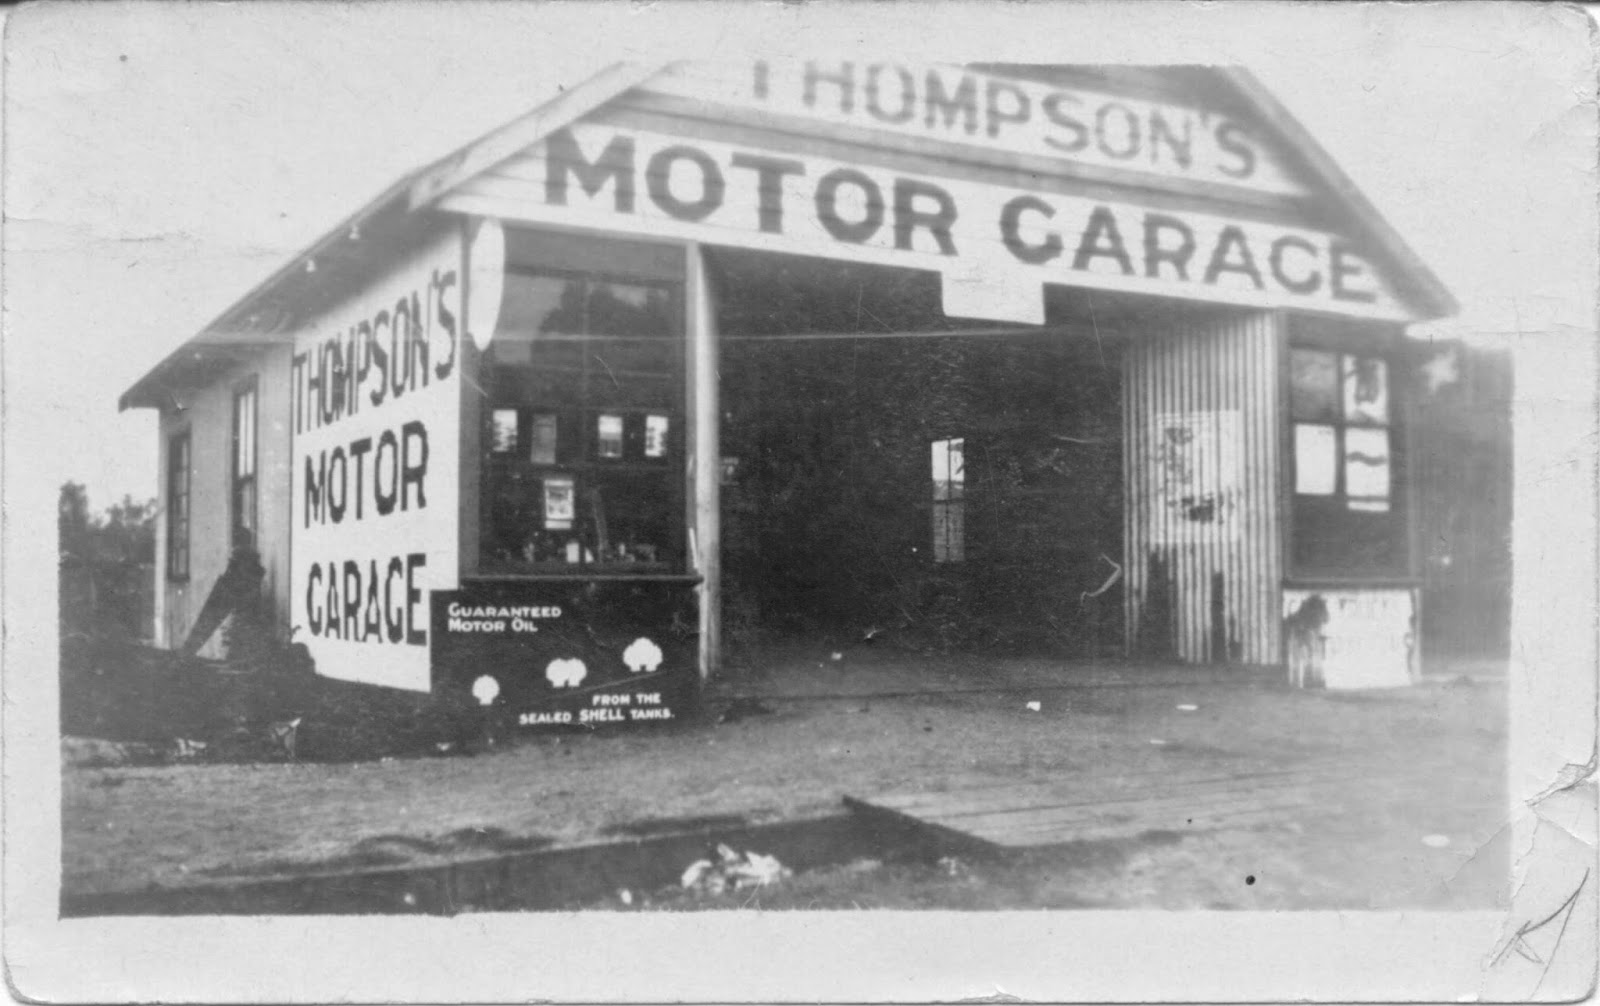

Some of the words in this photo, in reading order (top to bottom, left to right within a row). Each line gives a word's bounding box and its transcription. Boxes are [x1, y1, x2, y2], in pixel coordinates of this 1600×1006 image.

[545, 130, 958, 256] MOTOR
[999, 195, 1377, 304] GARAGE
[292, 269, 457, 435] THOMPSON'S
[304, 420, 429, 528] MOTOR
[306, 553, 428, 646] GARAGE
[448, 602, 562, 618] GUARANTEED
[448, 618, 505, 632] MOTOR
[511, 617, 539, 632] OIL
[519, 711, 572, 725] SEALED
[579, 708, 625, 722] SHELL
[592, 694, 631, 706] FROM
[636, 692, 662, 704] THE
